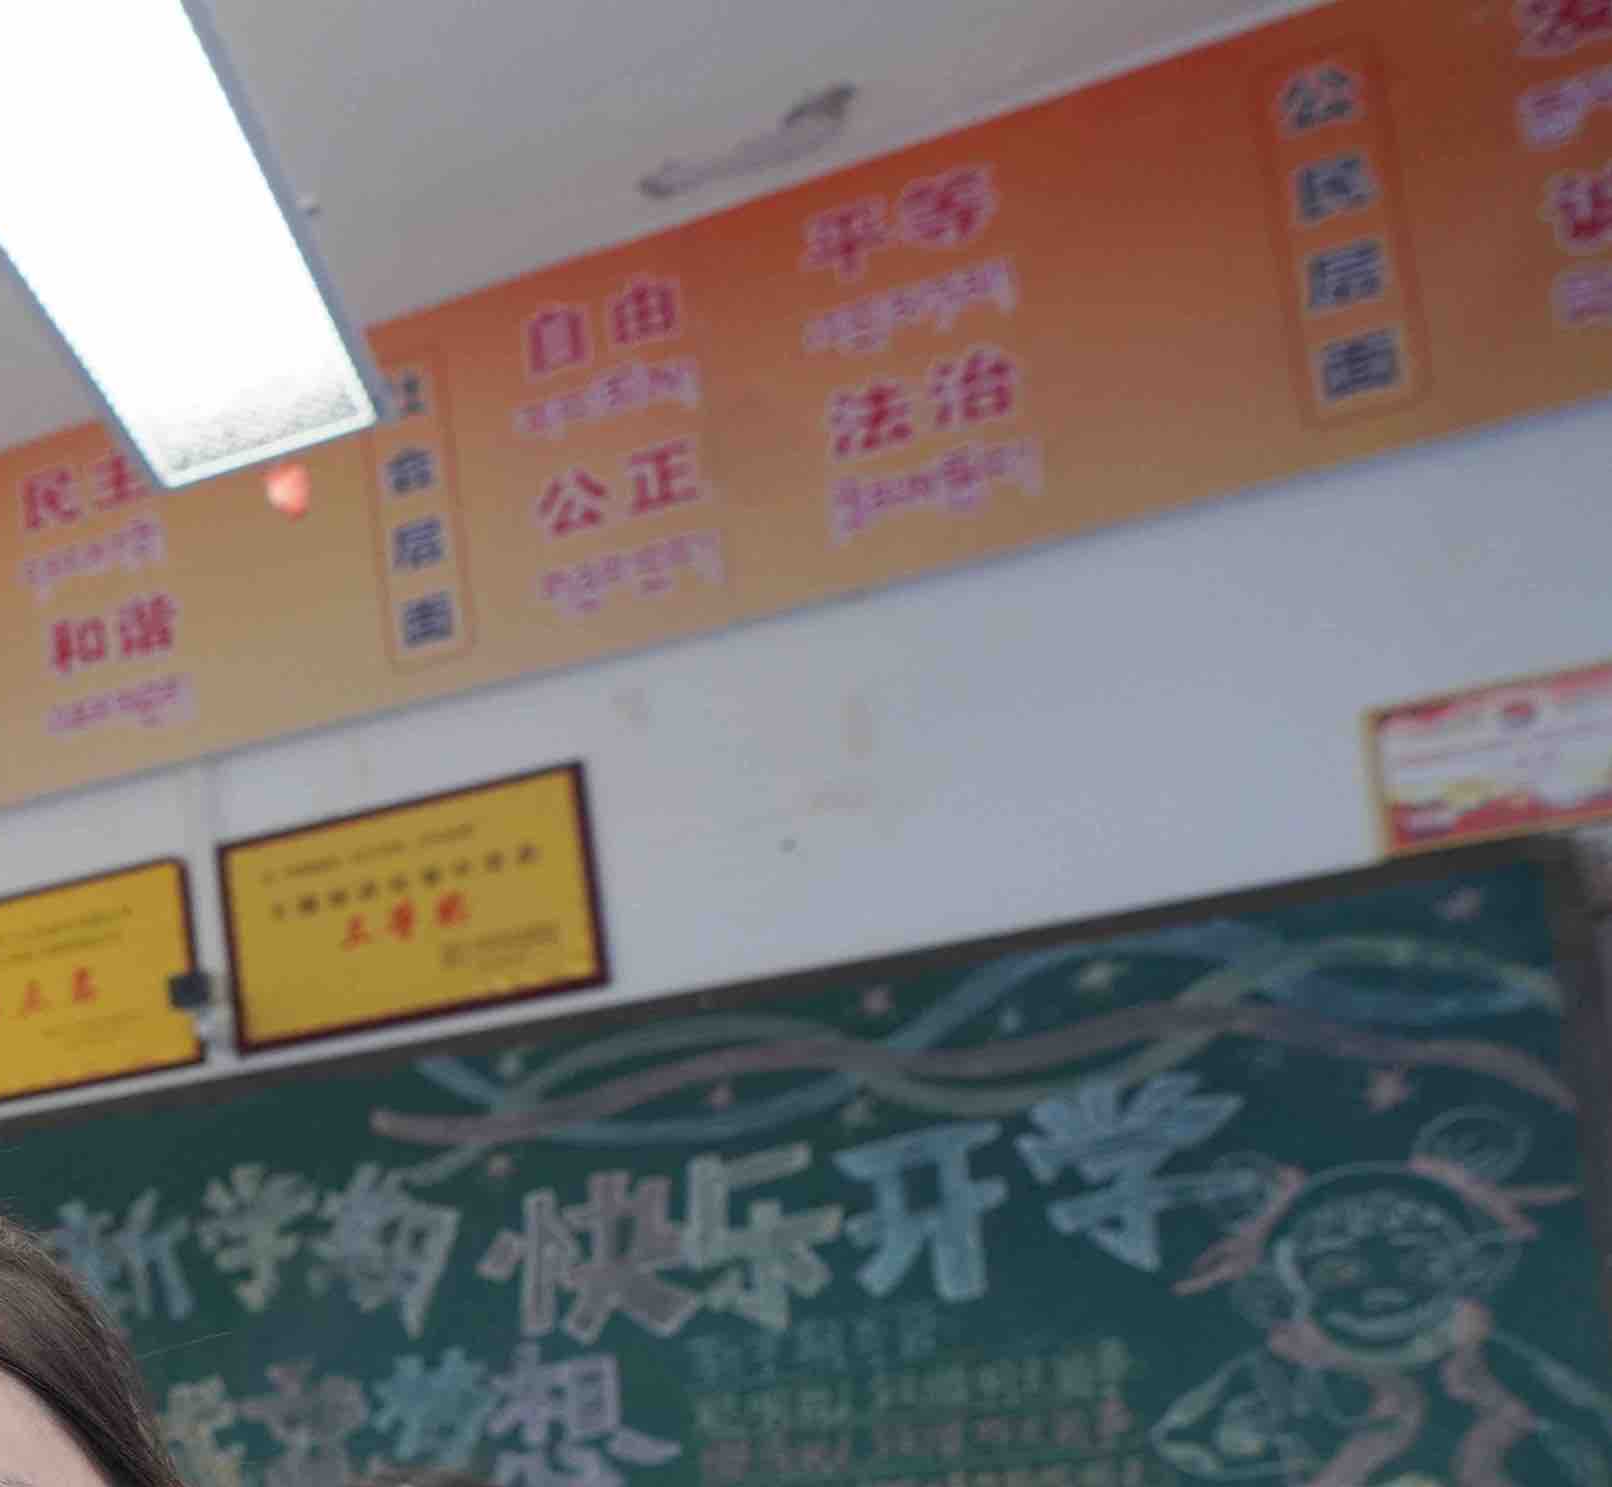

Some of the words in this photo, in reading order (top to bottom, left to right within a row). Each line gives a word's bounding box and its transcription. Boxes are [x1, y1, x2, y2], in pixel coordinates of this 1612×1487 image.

[803, 166, 994, 280] 平等
[1278, 63, 1401, 402] 公民层面
[521, 273, 680, 376] 自由
[828, 345, 1015, 459] 法治
[16, 453, 150, 532] 民主
[535, 439, 700, 538] 公正
[49, 592, 178, 676] 和谐
